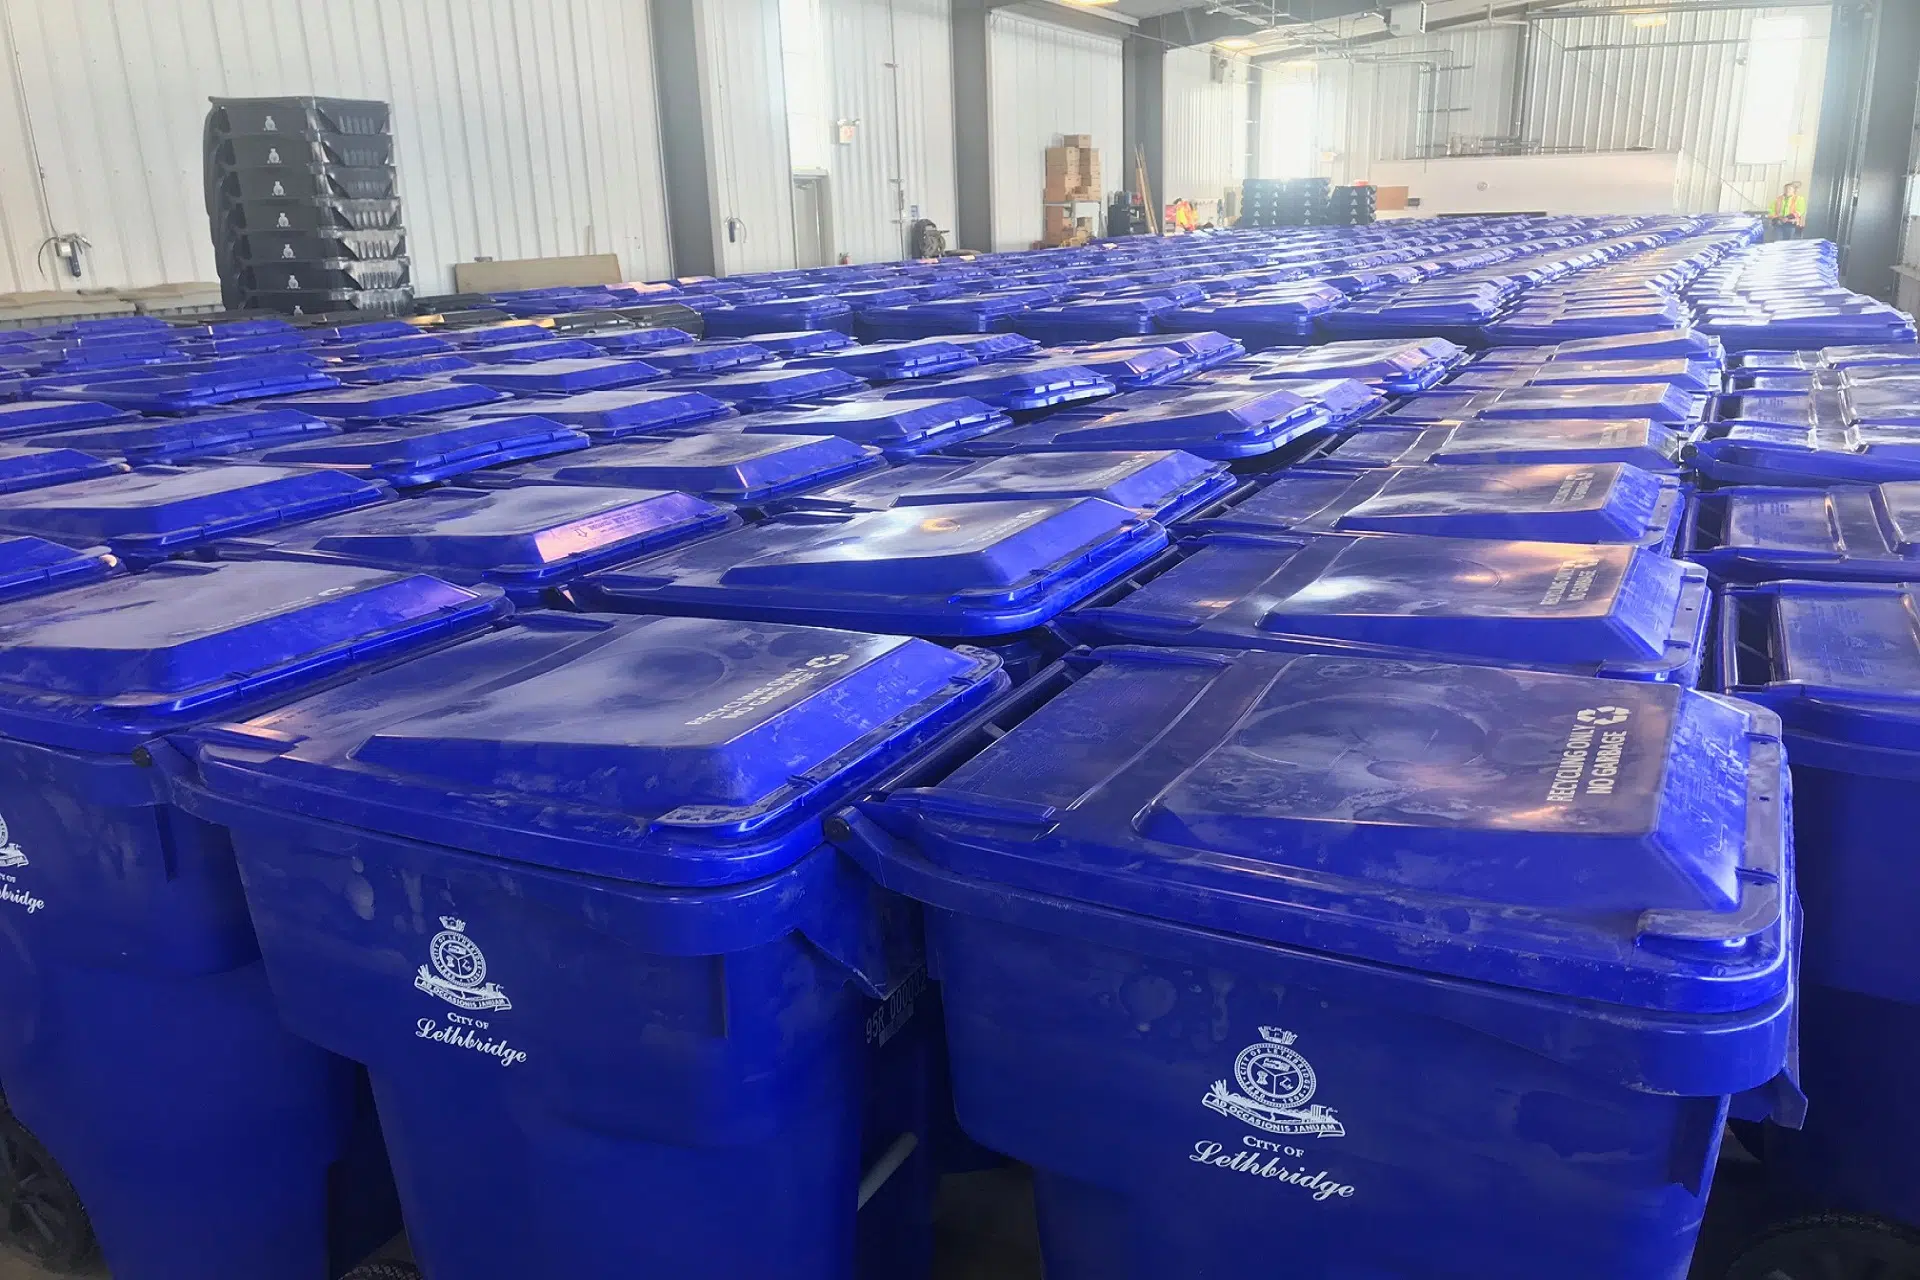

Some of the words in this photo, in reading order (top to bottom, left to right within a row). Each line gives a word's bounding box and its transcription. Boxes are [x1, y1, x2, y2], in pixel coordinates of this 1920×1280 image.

[721, 707, 755, 719] NO
[1566, 724, 1595, 749] ONLY
[1591, 730, 1628, 777] GARBAGE
[1546, 750, 1588, 802] RECYCLING
[1586, 778, 1615, 794] NO
[0, 884, 45, 914] bridge
[447, 1012, 473, 1026] CITY
[475, 1020, 489, 1030] OF
[866, 1006, 885, 1044] 95R
[415, 1018, 527, 1067] Lethbridge
[1212, 1099, 1227, 1108] AD
[1229, 1105, 1291, 1132] OCCASIONIS
[1294, 1123, 1336, 1133] JANUAM
[1242, 1135, 1282, 1153] CITY
[1284, 1146, 1305, 1158] OF
[1189, 1140, 1355, 1201] Lethbridge
